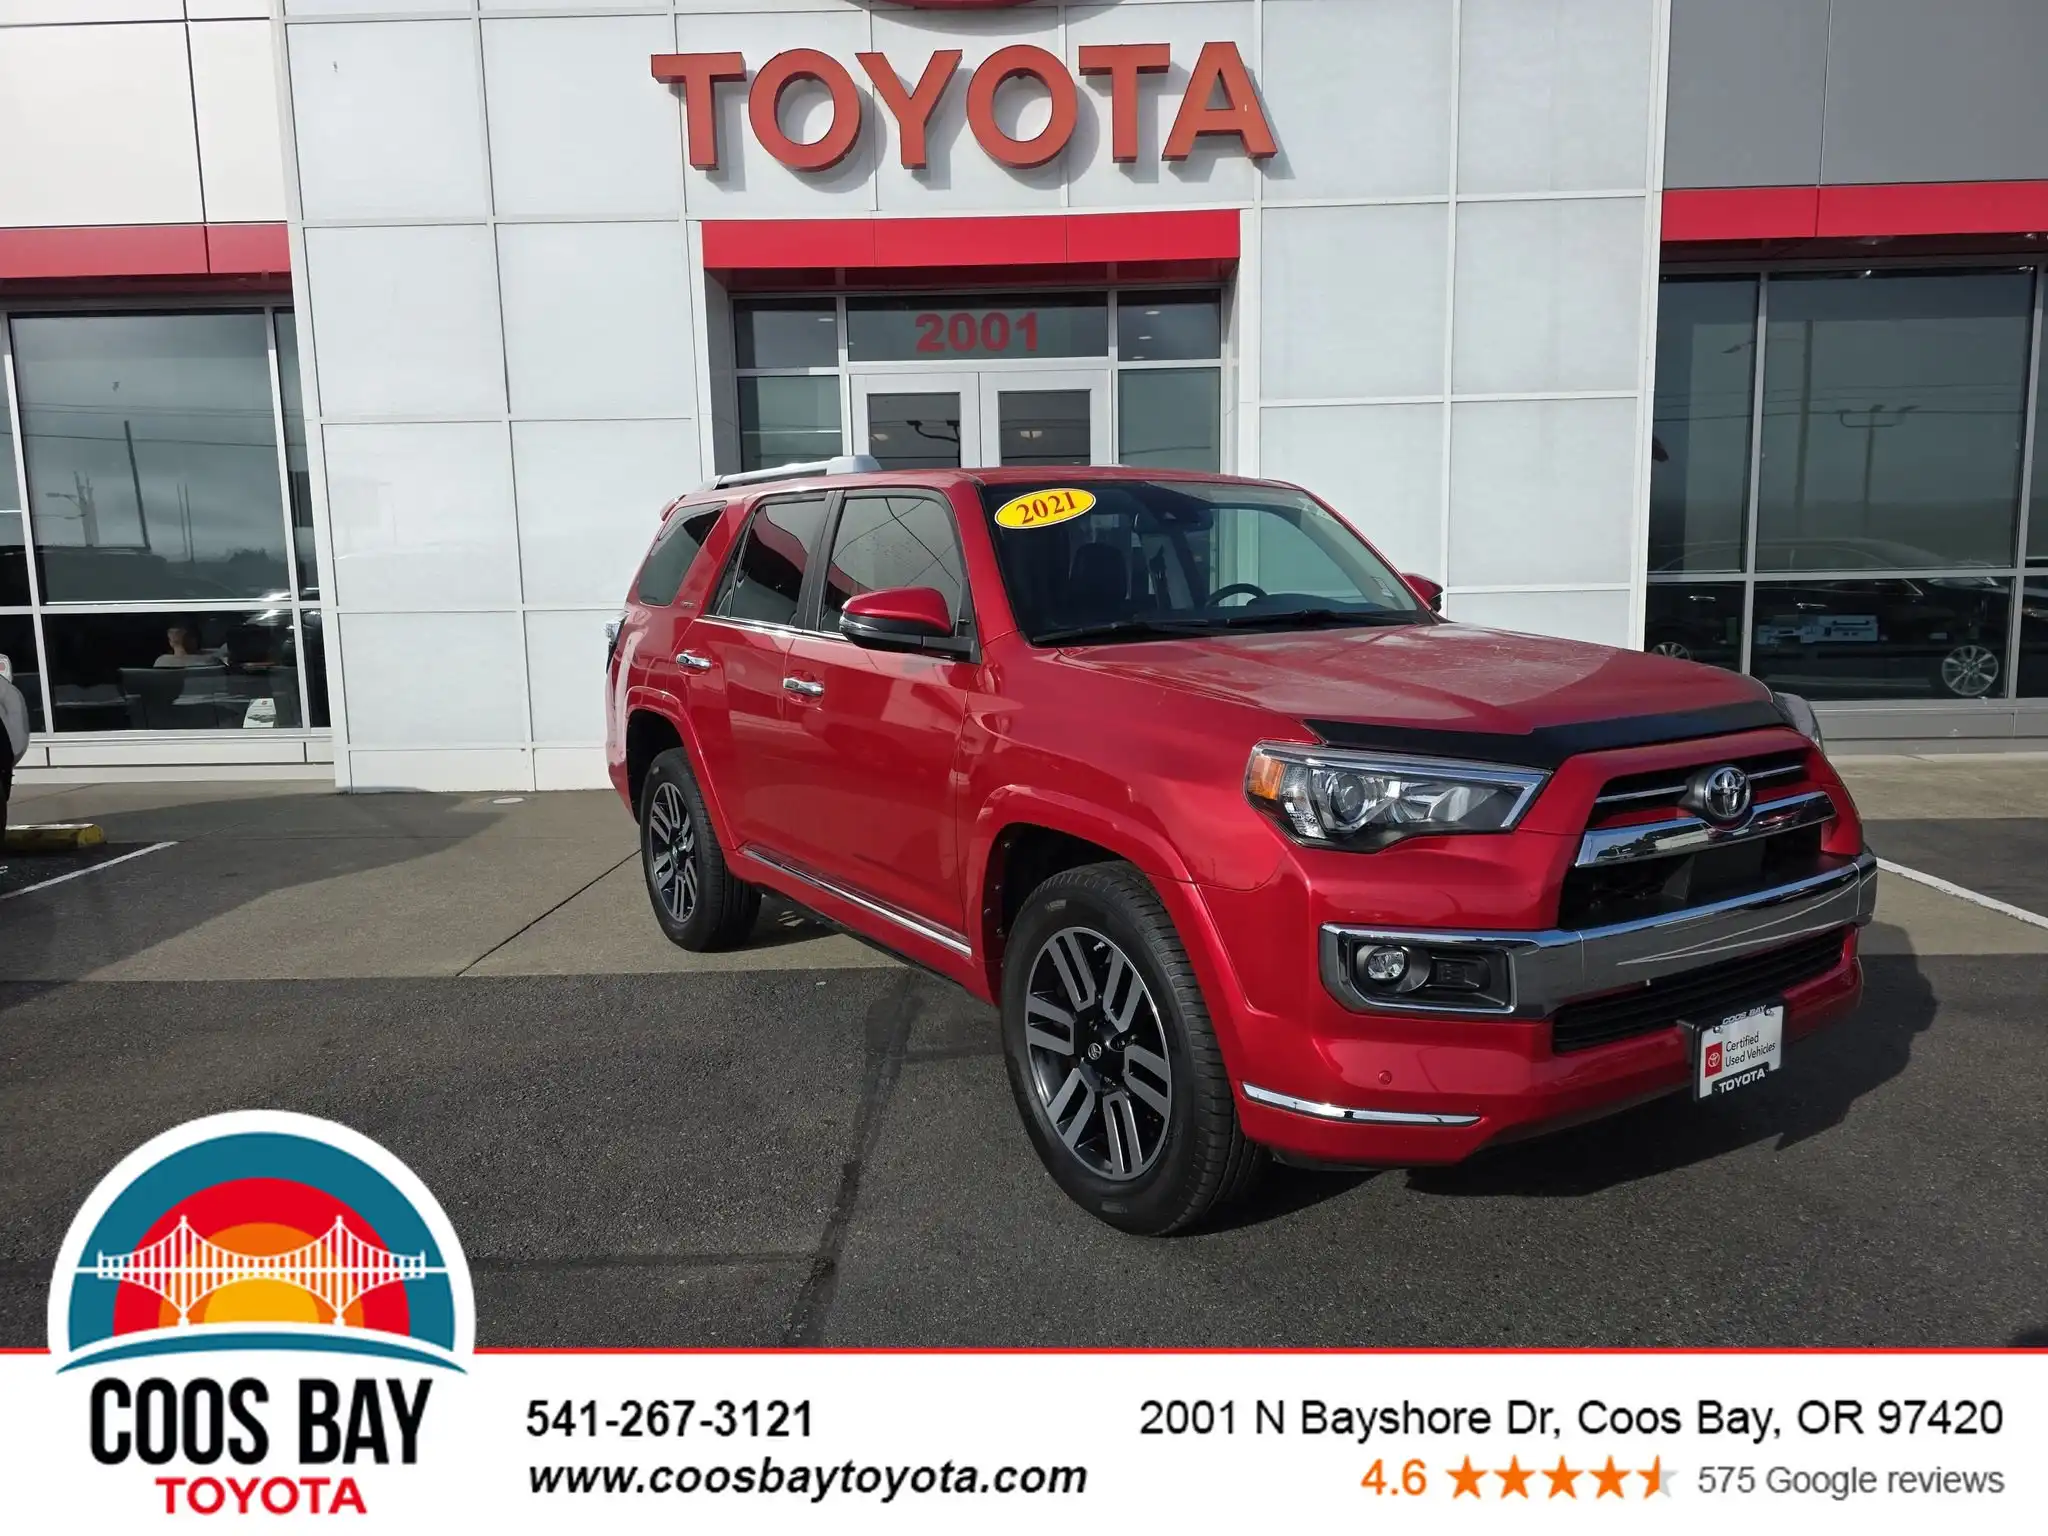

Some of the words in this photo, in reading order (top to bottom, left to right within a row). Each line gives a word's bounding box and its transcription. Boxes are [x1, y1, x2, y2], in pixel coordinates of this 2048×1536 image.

[651, 41, 1277, 170] TOYOTA
[916, 311, 1038, 352] 2001
[1016, 492, 1076, 524] 2021
[1722, 1011, 1747, 1026] COOS
[1748, 1004, 1767, 1018] BAY
[1725, 1031, 1759, 1053] Certified
[1725, 1051, 1746, 1068] Used
[1746, 1042, 1776, 1061] Vehicles
[1718, 1067, 1766, 1094] TOYOTA
